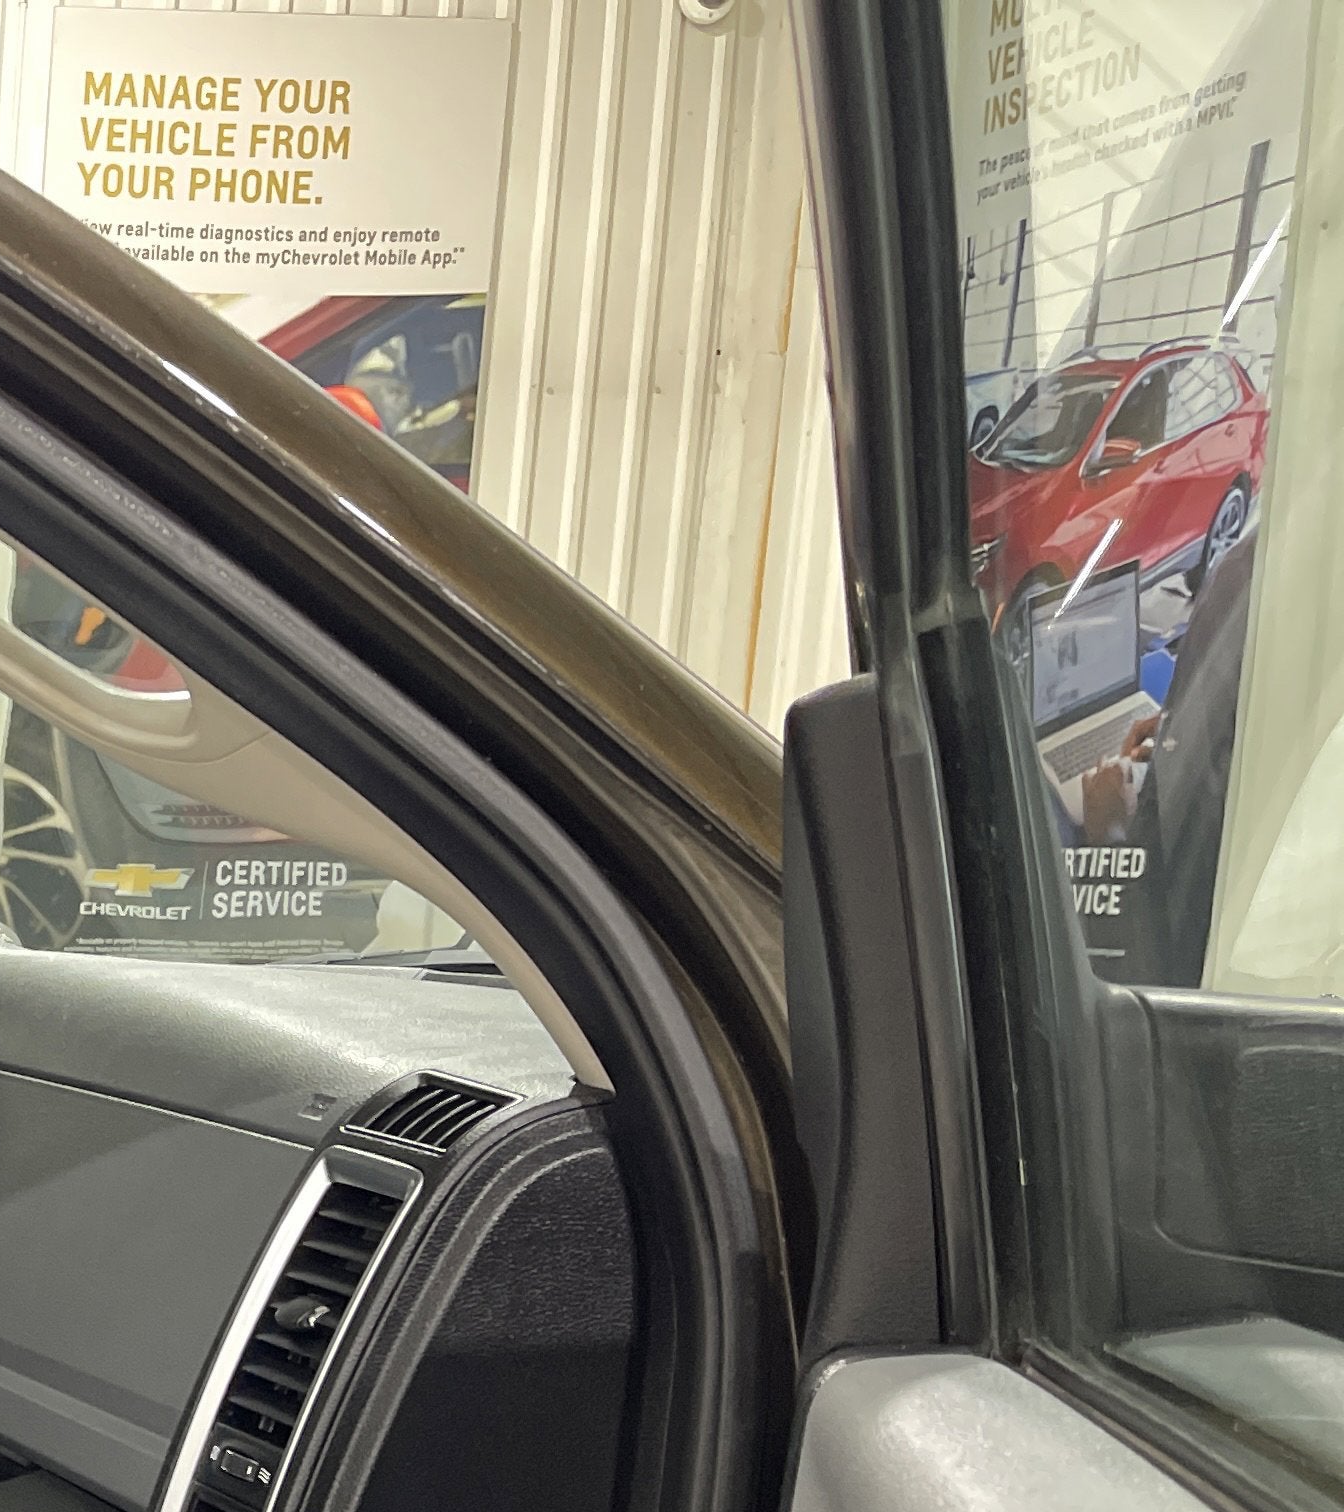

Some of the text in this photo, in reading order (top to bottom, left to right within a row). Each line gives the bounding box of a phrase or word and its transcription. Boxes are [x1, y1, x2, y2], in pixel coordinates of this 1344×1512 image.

[989, 9, 1096, 85] VEHICLE
[83, 71, 351, 115] MANAGE YOUR
[984, 42, 1141, 135] INSPECTION
[80, 117, 351, 160] VEHICLE FROM
[77, 162, 324, 205] YOUR PHONE.
[117, 220, 195, 239] real-time
[200, 223, 293, 245] diagnostics
[299, 227, 328, 243] and
[333, 227, 377, 247] enjoy
[381, 228, 441, 243] remote
[200, 251, 219, 264] on
[224, 247, 251, 264] the
[256, 250, 360, 269] myChevrolet
[364, 250, 417, 266] Mobile
[216, 860, 348, 886] CERTIFIED
[1064, 847, 1146, 878] RTIFIED
[80, 901, 192, 921] CHEVROLET
[212, 890, 323, 919] SERVICE
[1072, 884, 1125, 915] VICE
